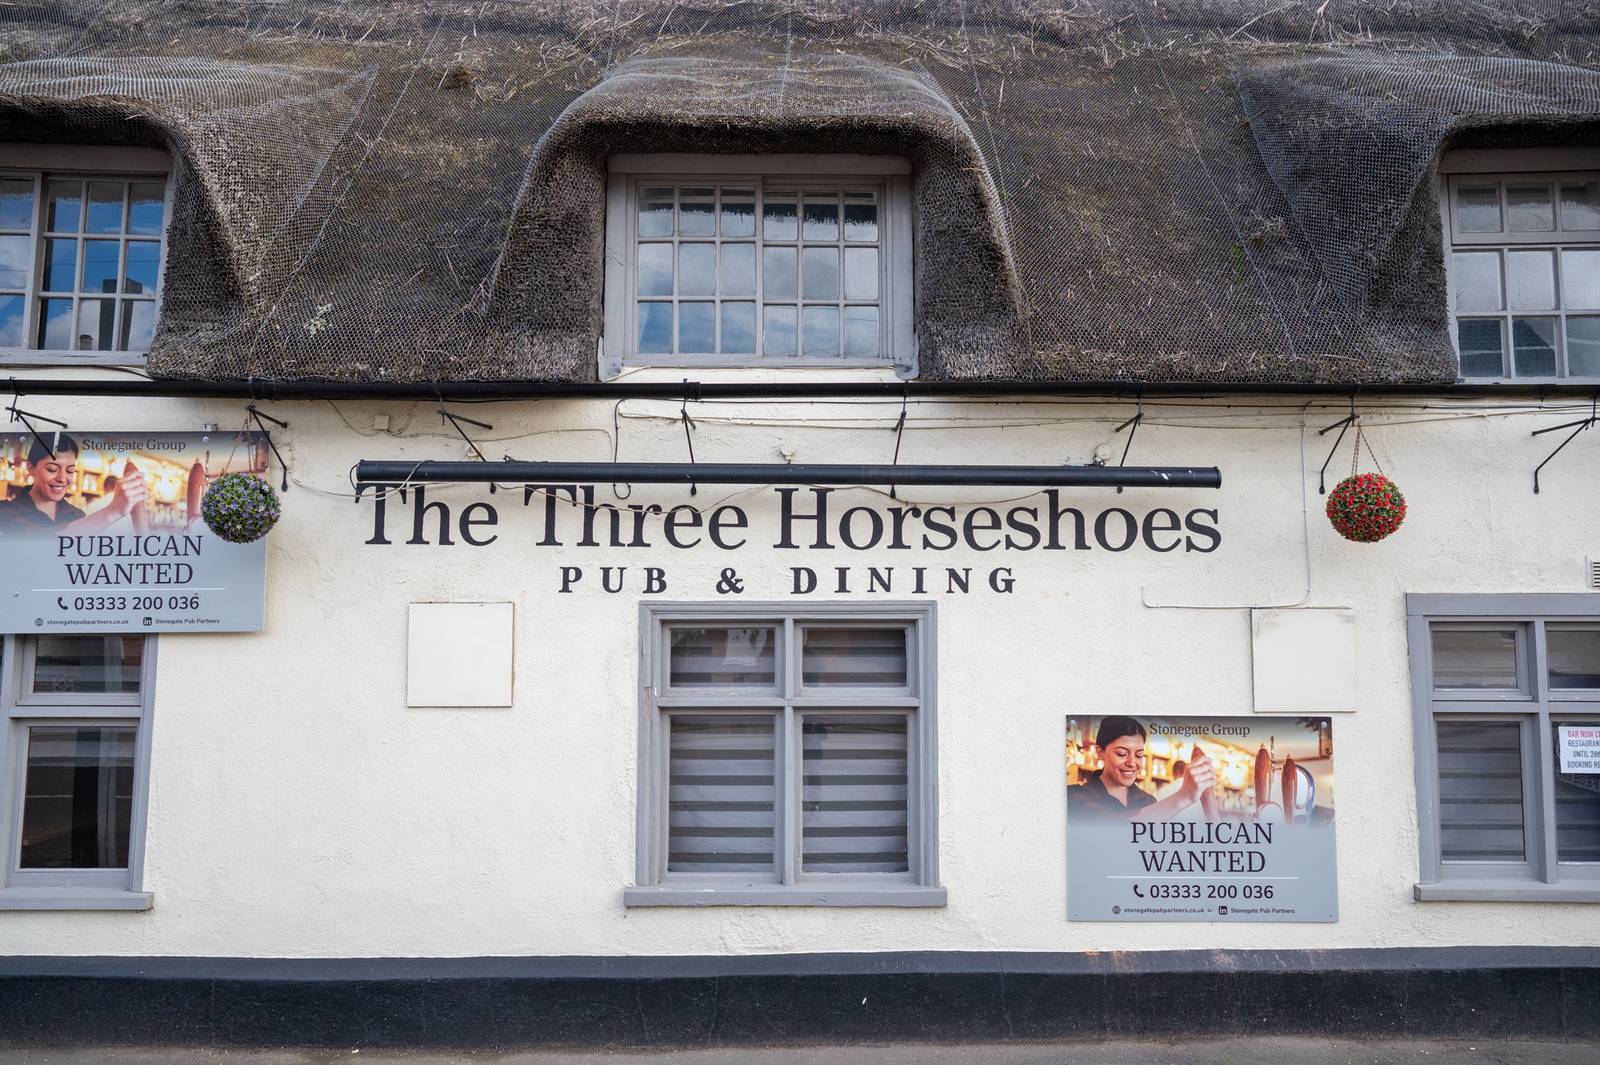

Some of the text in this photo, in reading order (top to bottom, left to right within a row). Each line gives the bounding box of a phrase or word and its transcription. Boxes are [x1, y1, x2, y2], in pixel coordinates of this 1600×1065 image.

[82, 438, 186, 453] Stonegate Group
[354, 481, 1222, 553] The Three Horseshoes
[57, 535, 203, 557] PUBLICAN
[65, 563, 194, 585] WANTED
[558, 566, 1016, 594] PUB & DINING
[74, 596, 200, 611] 03333 200 036
[46, 619, 129, 627] stonegatepubpartners.co.uk
[155, 618, 183, 626] Stonegate
[1149, 723, 1251, 738] Stonegate Group
[1130, 821, 1273, 845] PUBLICAN
[1139, 850, 1266, 873] WANTED
[1149, 884, 1274, 899] 03333 200 036
[1123, 906, 1205, 915] stonegatepubpartners.co.uk
[1230, 907, 1259, 916] Stonegate
[1260, 907, 1271, 915] Pub
[1272, 907, 1296, 915] Partners
